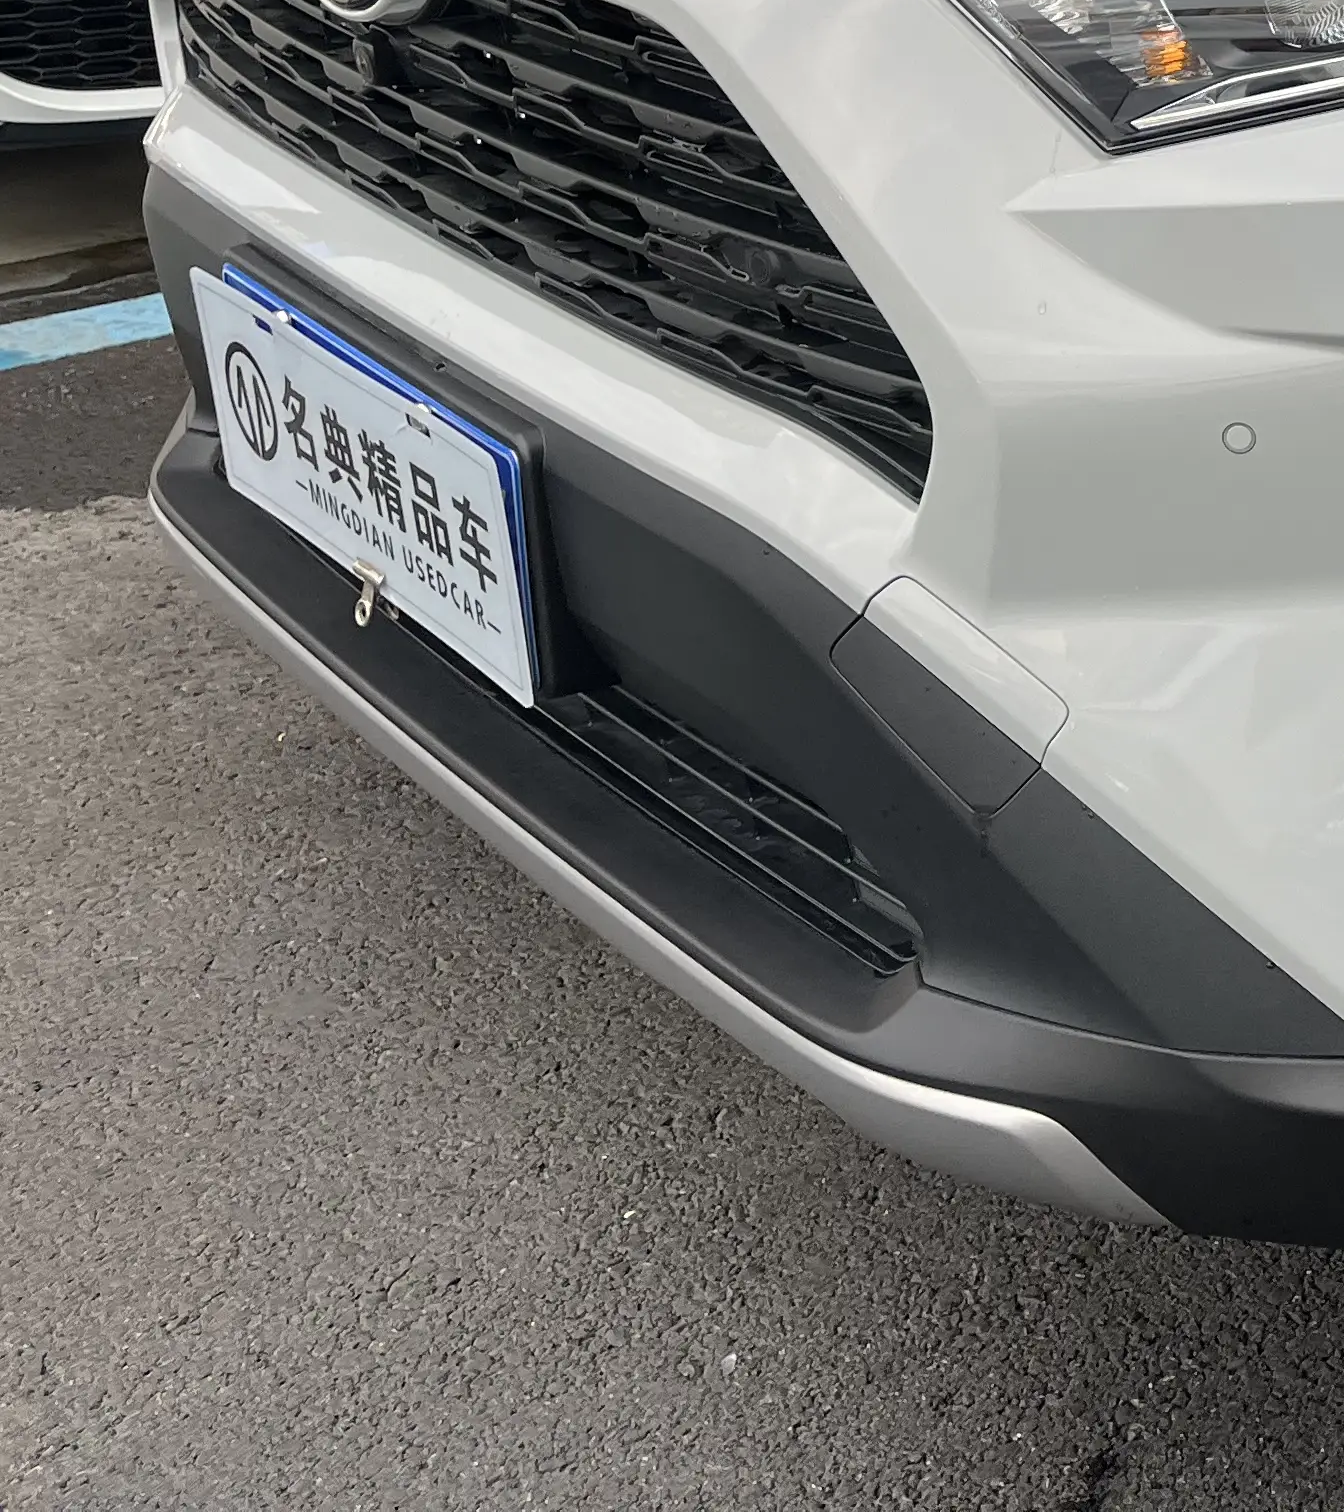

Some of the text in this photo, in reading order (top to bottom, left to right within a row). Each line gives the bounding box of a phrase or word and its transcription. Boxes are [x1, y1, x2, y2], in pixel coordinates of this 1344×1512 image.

[281, 374, 498, 593] 名典精品车
